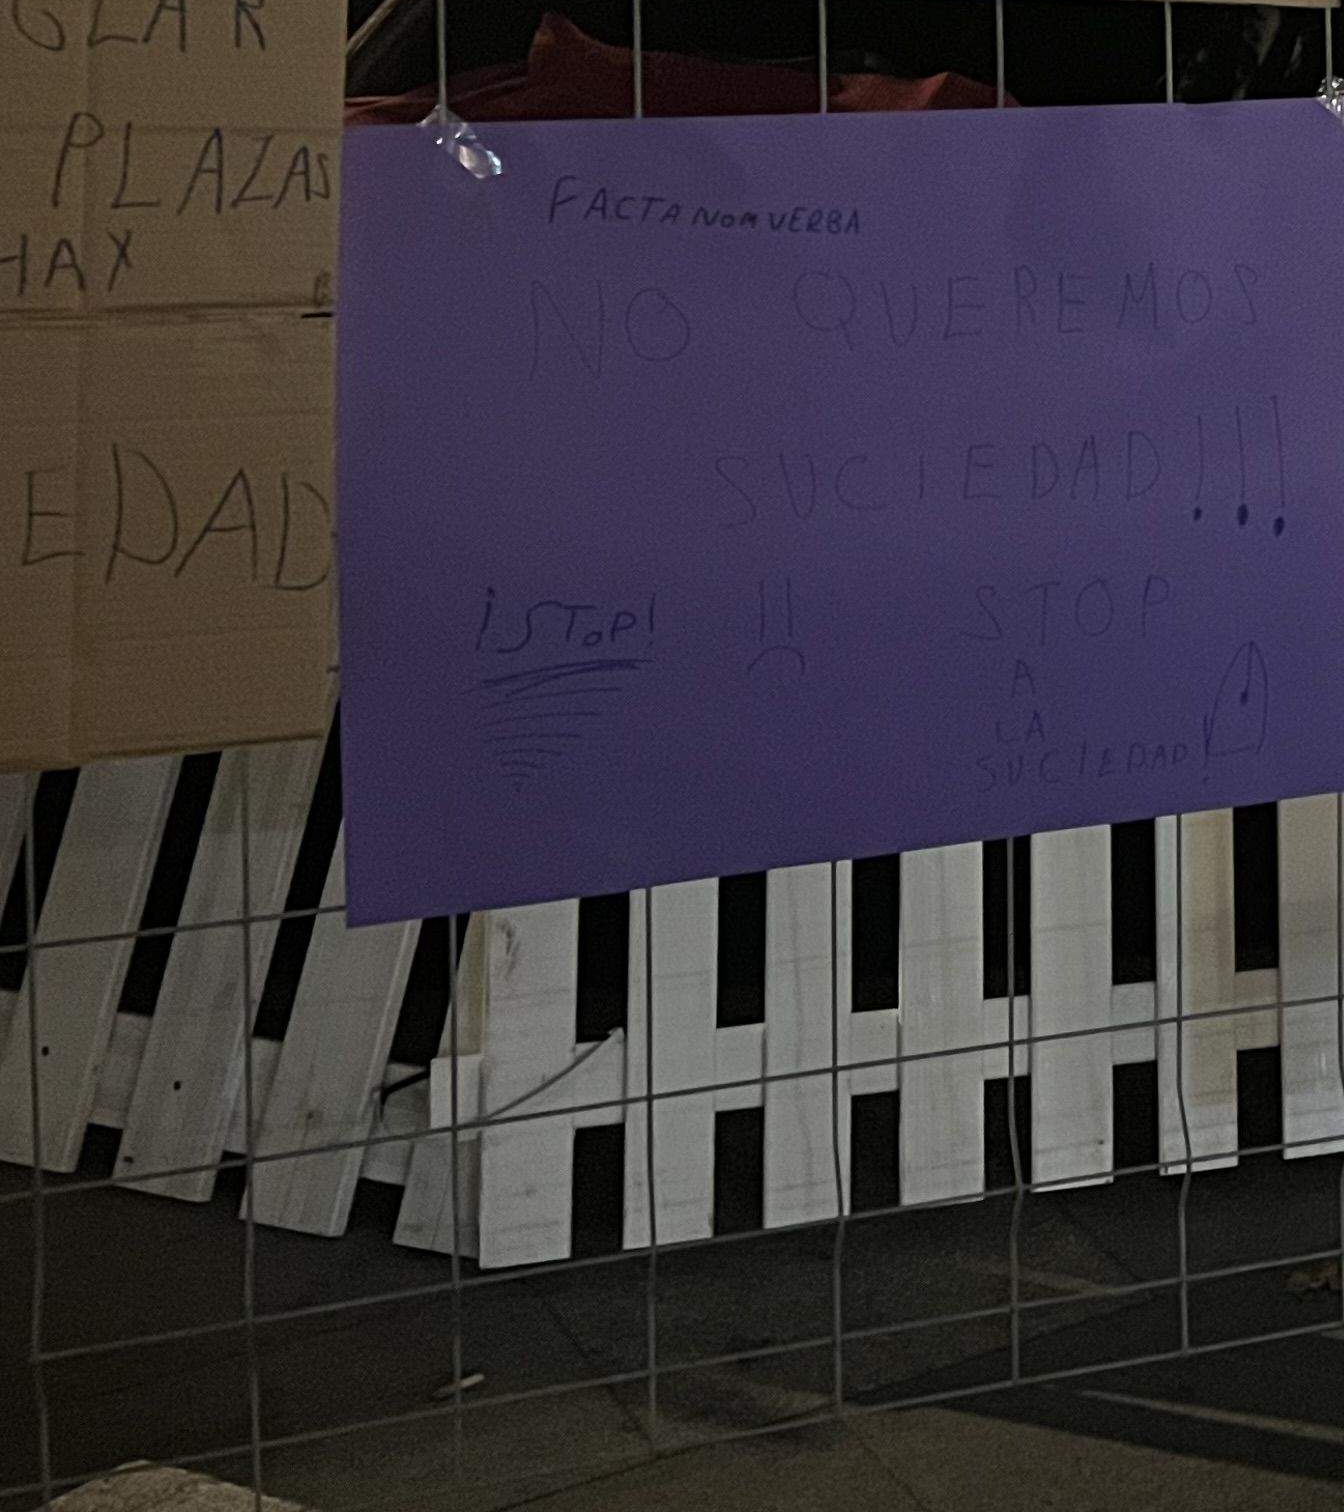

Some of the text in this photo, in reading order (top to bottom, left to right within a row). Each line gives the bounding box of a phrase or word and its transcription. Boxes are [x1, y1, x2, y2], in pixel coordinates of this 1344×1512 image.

[49, 109, 332, 217] PLAZAS
[546, 174, 683, 226] FACTA
[768, 206, 862, 237] VERBA
[526, 261, 1262, 382] NO QUEREMOS
[958, 573, 1171, 647] STOP
[1010, 658, 1037, 699] A
[994, 708, 1047, 745] LA
